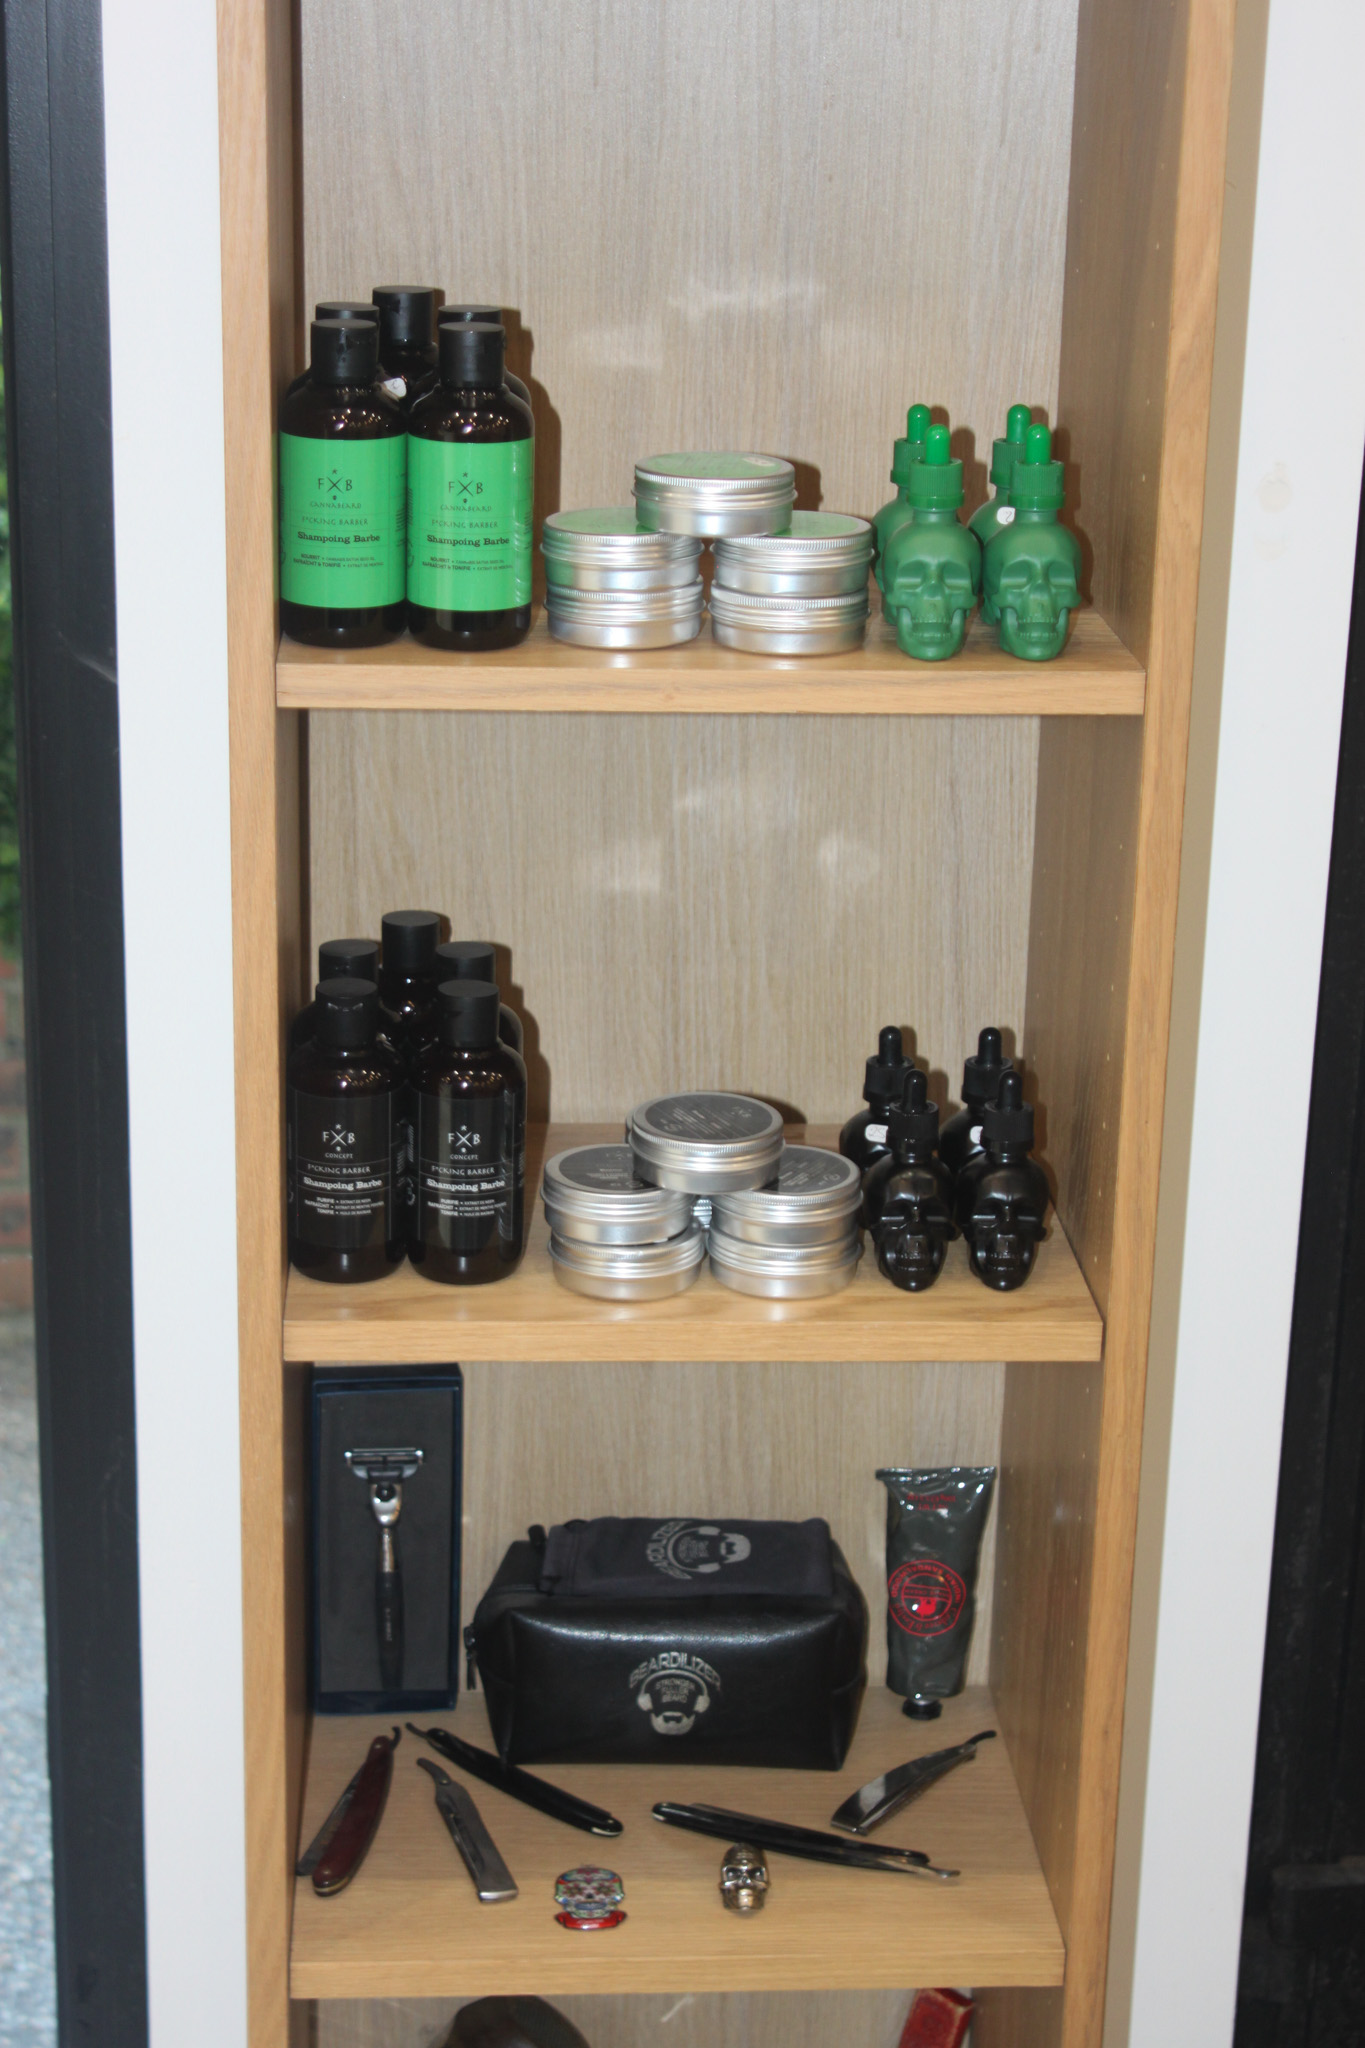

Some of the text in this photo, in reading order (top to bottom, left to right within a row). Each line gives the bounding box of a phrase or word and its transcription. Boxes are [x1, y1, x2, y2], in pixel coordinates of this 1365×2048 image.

[310, 501, 362, 510] CANNABEARD
[440, 504, 492, 512] CANNABEARD
[339, 518, 368, 526] BARBER
[469, 521, 499, 529] BARBER
[297, 531, 381, 544] Shampoing Barbe
[426, 534, 510, 547] Shampoing Barbe
[450, 1153, 479, 1161] CONCEPT
[342, 1166, 371, 1175] BARBER
[467, 1167, 495, 1175] BARBER
[303, 1176, 382, 1191] Shampoing Barbe
[426, 1178, 505, 1192] Shampoing Barbe
[630, 1652, 721, 1692] BEARDILIZER
[662, 1695, 688, 1703] BEARD
